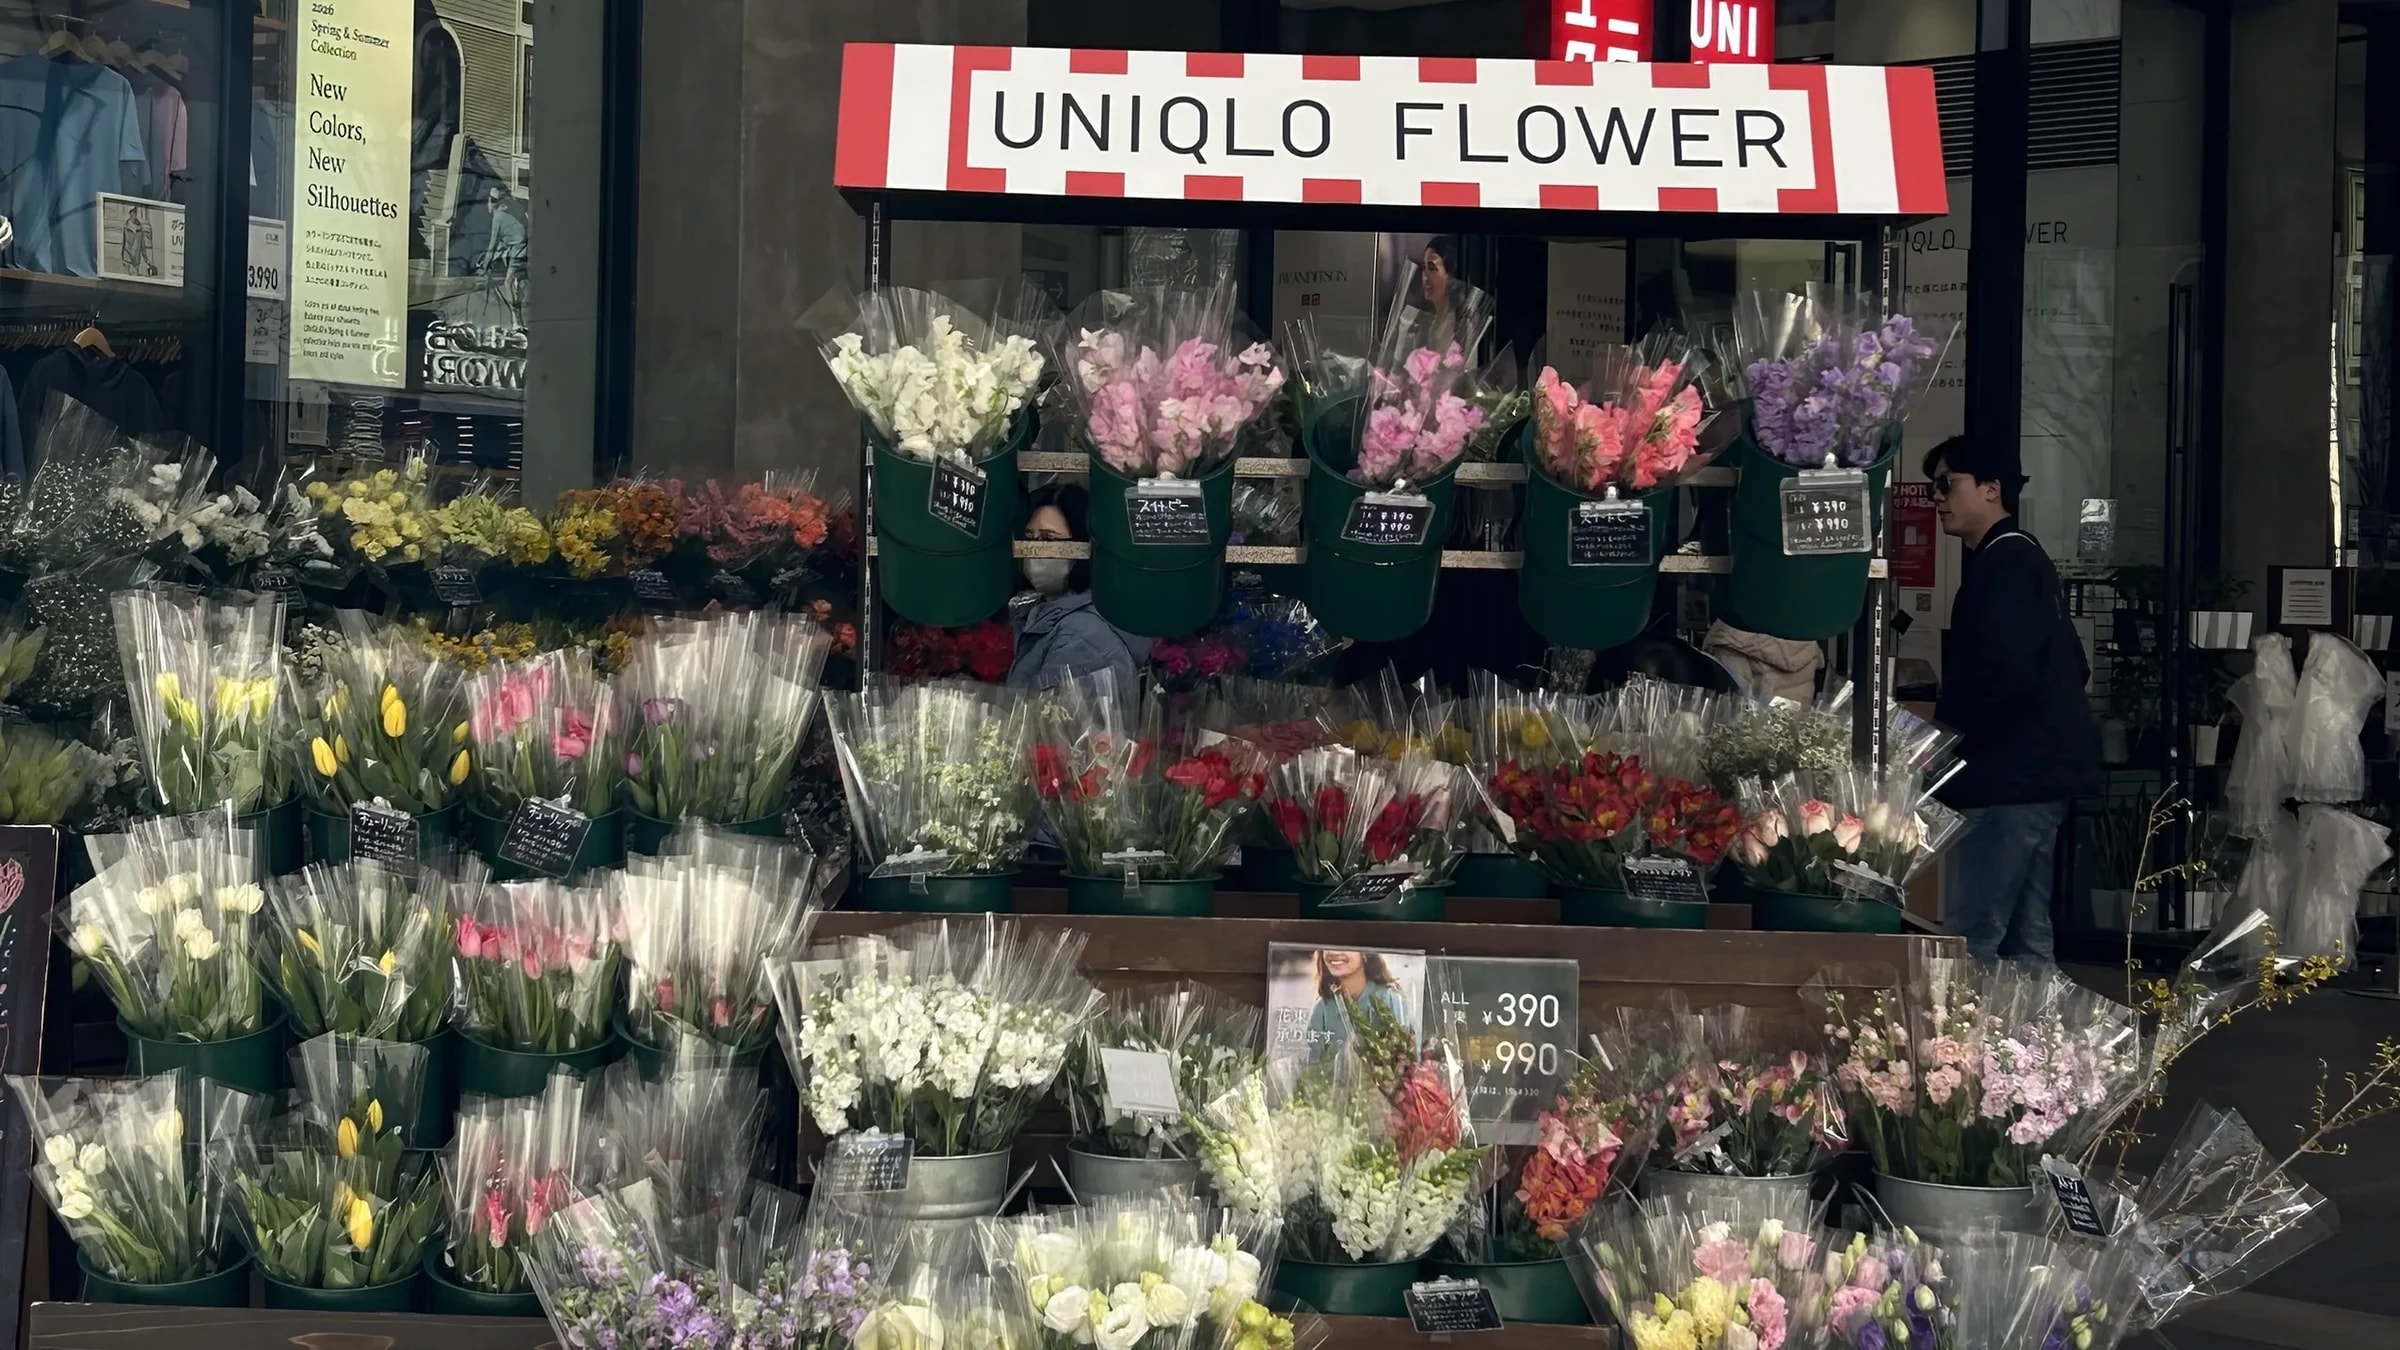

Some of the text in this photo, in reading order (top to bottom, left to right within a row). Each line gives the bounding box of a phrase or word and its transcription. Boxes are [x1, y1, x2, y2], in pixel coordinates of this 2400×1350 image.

[311, 20, 341, 40] Spring
[343, 27, 350, 39] &
[311, 39, 357, 60] Collection
[310, 73, 347, 101] New
[309, 110, 366, 145] Colors,
[994, 91, 1788, 168] UNIQLO FLOWER
[309, 146, 346, 173] New
[307, 183, 398, 219] Silhouettes
[1441, 991, 1470, 1006] ALL
